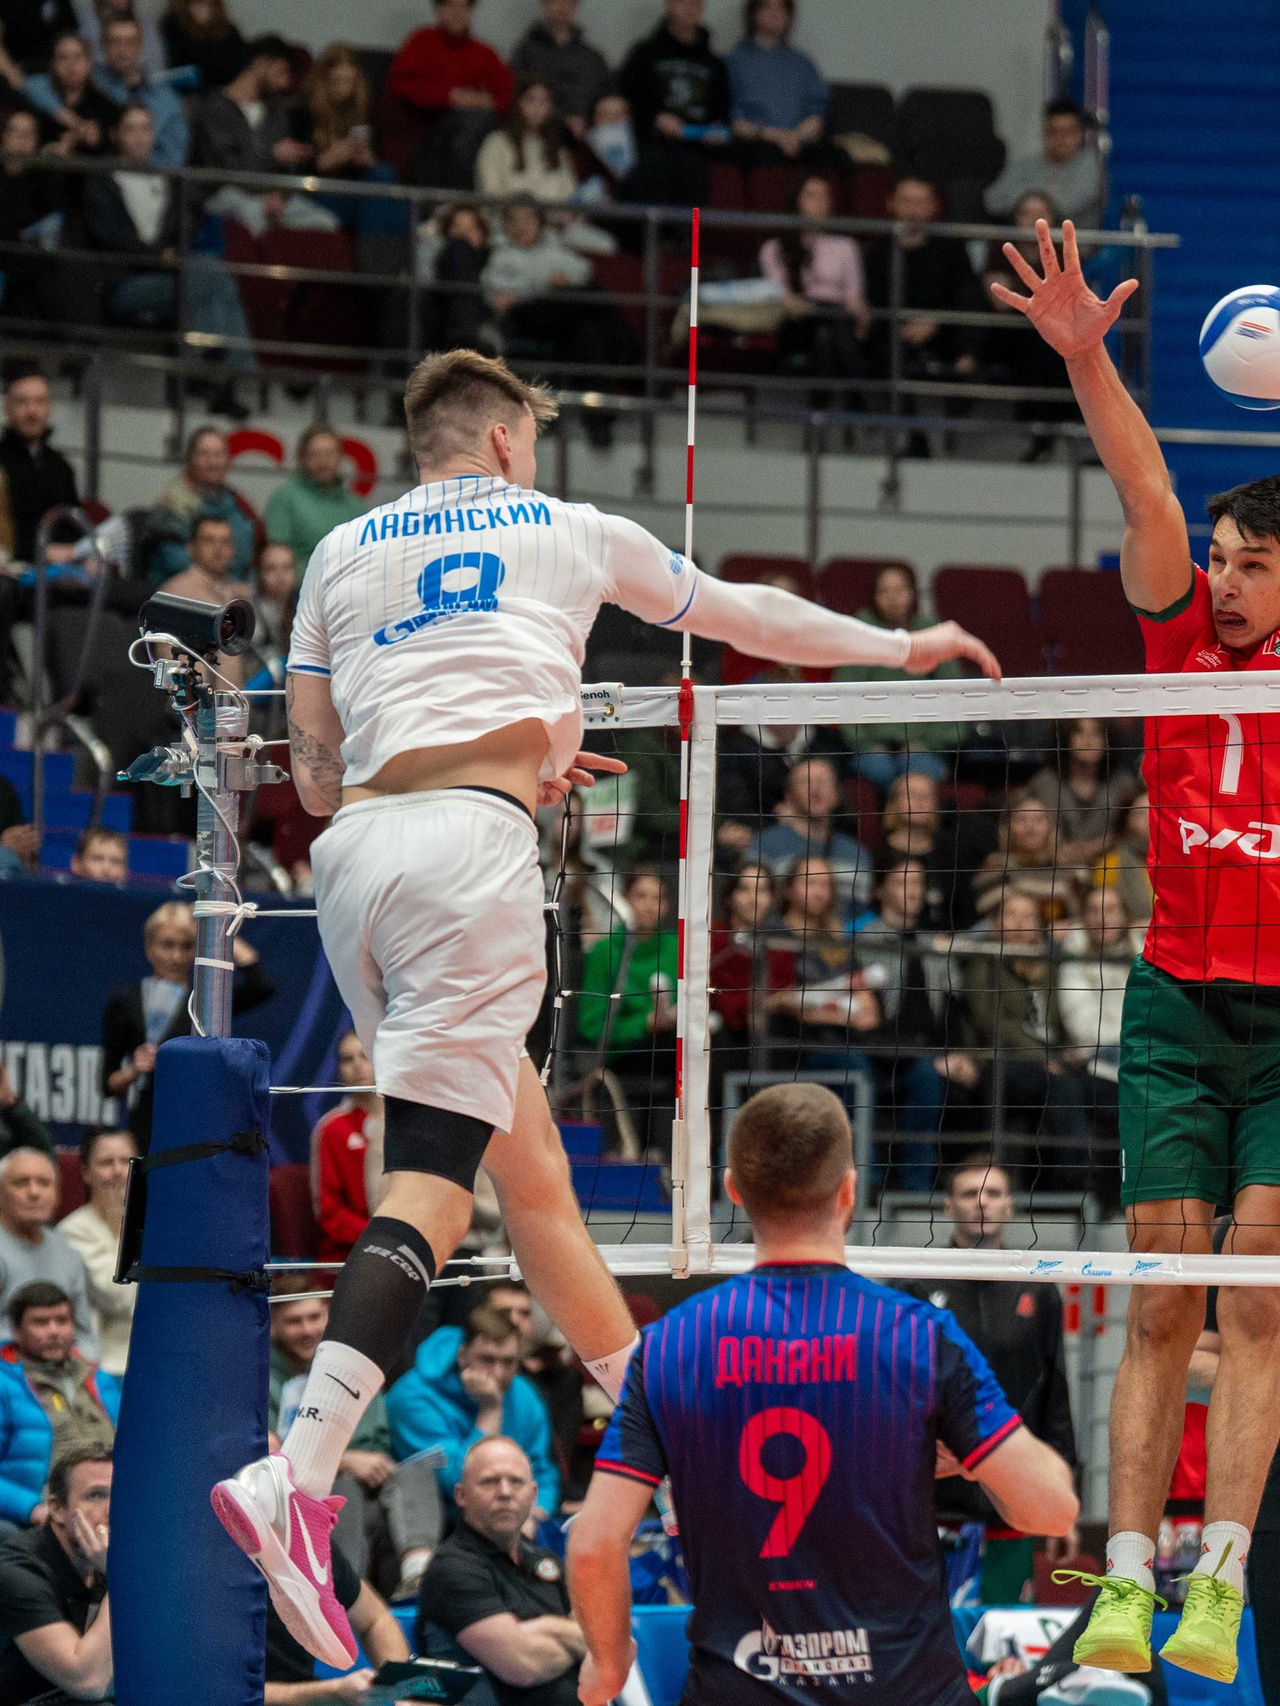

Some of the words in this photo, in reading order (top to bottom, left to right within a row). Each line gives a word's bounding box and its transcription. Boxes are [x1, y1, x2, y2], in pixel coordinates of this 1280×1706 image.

[1218, 713, 1244, 796] 1
[715, 1334, 857, 1388] ДАНАНИ
[738, 1406, 832, 1559] 9
